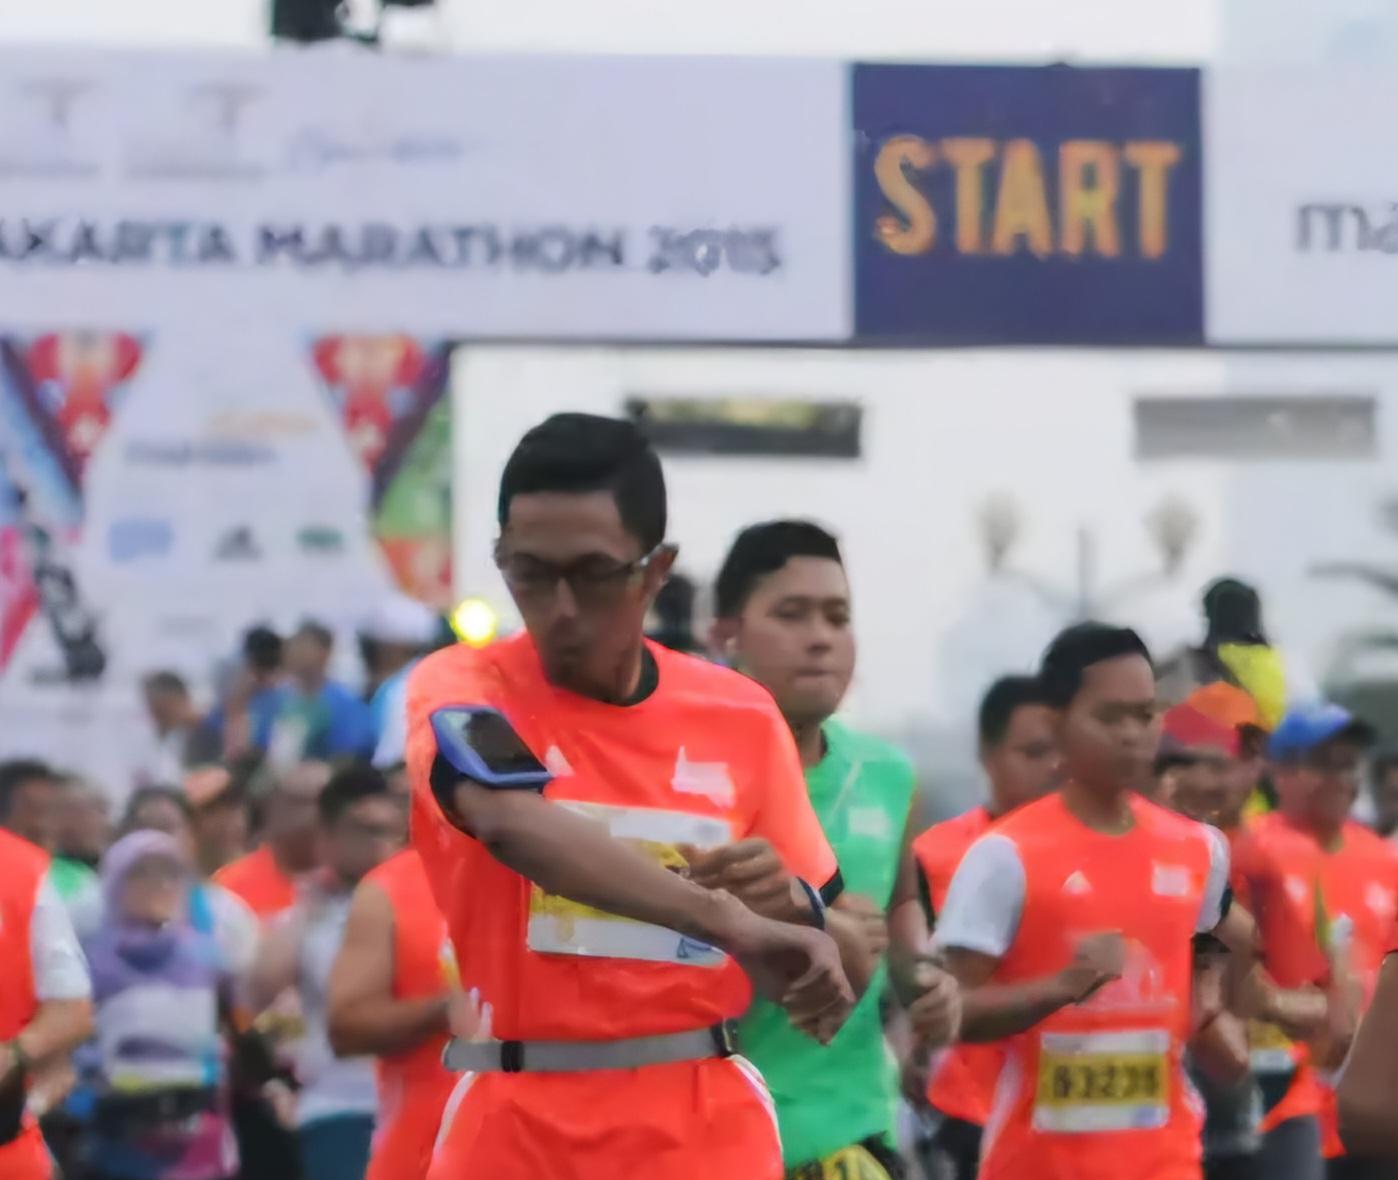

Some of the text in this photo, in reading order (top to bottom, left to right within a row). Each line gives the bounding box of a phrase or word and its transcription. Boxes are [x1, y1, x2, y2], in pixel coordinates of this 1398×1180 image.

[872, 134, 1182, 260] START
[254, 221, 625, 272] MARATHON
[645, 224, 783, 277] 2015
